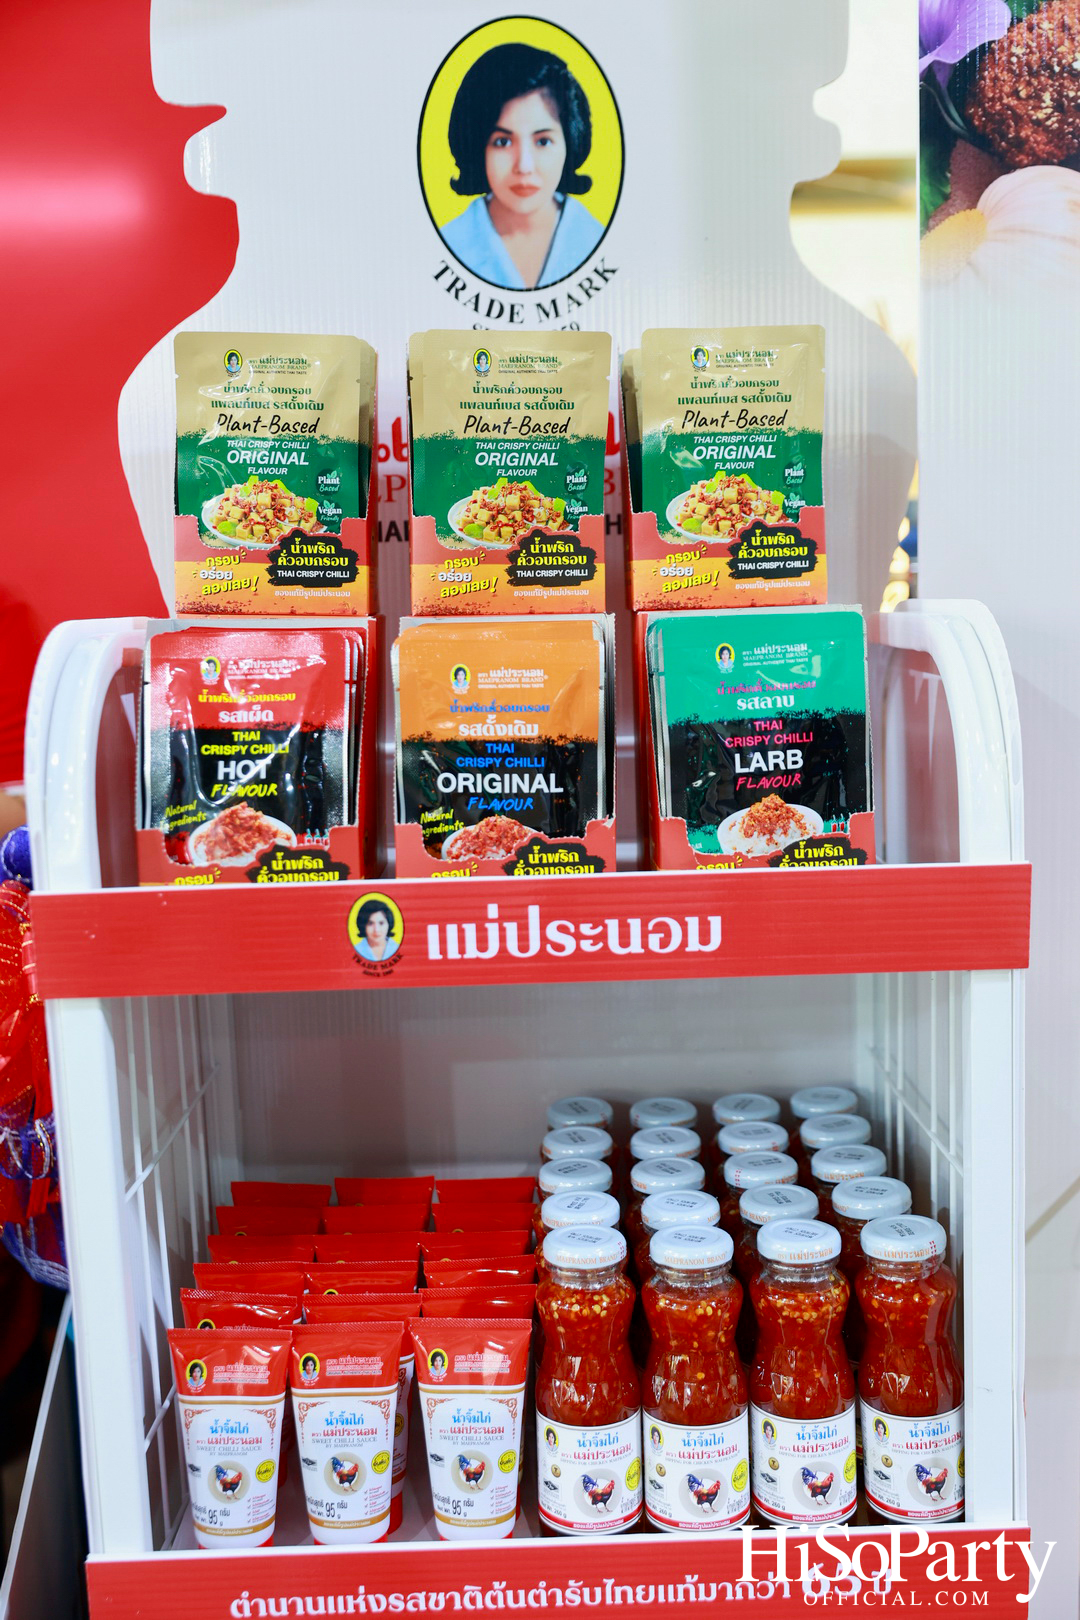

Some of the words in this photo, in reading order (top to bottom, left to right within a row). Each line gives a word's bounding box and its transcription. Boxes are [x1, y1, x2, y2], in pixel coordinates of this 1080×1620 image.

[433, 260, 524, 324] TRADE
[535, 257, 620, 324] MARK
[472, 381, 563, 395] น้ำพริกคั่วอบกรอบ
[211, 398, 270, 410] แพลนท์เบส
[273, 396, 325, 411] รสดั้งเดิม
[460, 398, 521, 410] แพลนท์เบส
[524, 396, 575, 411] รสดั้งเดิม
[677, 393, 738, 405] แพลนท์เบส
[741, 389, 792, 404] รสดั้งเดิม
[217, 413, 321, 434] Plant-Based
[463, 414, 571, 436] Plant-Based
[682, 408, 788, 429] Plant-Based
[227, 440, 247, 448] THAI
[248, 440, 281, 449] CRISPY
[282, 441, 310, 449] CHILLI
[475, 441, 495, 450] THAI
[496, 441, 531, 451] CRISPY
[532, 441, 560, 450] CHILLI
[693, 436, 714, 444] THAI
[715, 435, 748, 444] CRISPY
[749, 434, 777, 442] CHILLI
[227, 450, 310, 466] ORIGINAL
[475, 451, 559, 466] ORIGINAL
[693, 444, 776, 460] ORIGINAL
[247, 466, 288, 475] FLAVOUR
[496, 468, 538, 477] FLAVOUR
[714, 462, 755, 470] FLAVOUR
[784, 468, 804, 477] Plant
[318, 475, 340, 485] Plant
[566, 474, 587, 484] Plant
[786, 476, 804, 485] Based
[319, 484, 340, 492] Based
[567, 482, 586, 492] Based
[565, 504, 588, 515] Vegan
[784, 498, 806, 508] Vegan
[318, 506, 343, 516] Vegan
[751, 529, 795, 545] น้ำพริก
[290, 538, 336, 555] น้ำพริก
[530, 537, 574, 554] น้ำพริก
[738, 542, 808, 559] คั่วอบกรอบ
[205, 555, 240, 568] กรอบ
[277, 549, 349, 566] คั่วอบกรอบ
[444, 556, 479, 570] กรอบ
[517, 549, 587, 566] คั่วอบกรอบ
[666, 550, 700, 565] กรอบ
[660, 564, 694, 577] อร่อย
[738, 563, 756, 571] THAI
[757, 562, 784, 570] CRISPY
[785, 560, 809, 569] CHILLI
[199, 567, 233, 581] อร่อย
[277, 570, 295, 578] THAI
[296, 570, 324, 578] CRISPY
[325, 570, 350, 578] CHILLI
[438, 569, 472, 582] อร่อย
[516, 570, 535, 578] THAI
[536, 569, 563, 578] CRISPY
[564, 569, 588, 578] CHILLI
[737, 695, 794, 711] รสลาบ
[218, 704, 274, 723] รสเผ็ด
[459, 714, 538, 736] รสดั้งเดิม
[754, 720, 782, 732] THAI
[232, 731, 261, 742] THAI
[725, 734, 771, 748] CRISPY
[774, 732, 814, 744] CHILLI
[200, 745, 248, 756] CRISPY
[250, 744, 290, 754] CHILLI
[485, 743, 515, 754] THAI
[456, 757, 502, 768] CRISPY
[504, 757, 545, 768] CHILLI
[734, 749, 804, 774] LARB
[217, 759, 272, 781] HOT
[436, 772, 564, 794] ORIGINAL
[736, 773, 802, 791] FLAVOUR
[467, 797, 534, 812] FLAVOUR
[420, 809, 454, 824] Natural
[421, 821, 464, 837] ngredients
[528, 846, 579, 864] น้ำพริก
[794, 841, 844, 859] น้ำพริก
[271, 852, 324, 871] น้ำพริก
[426, 903, 723, 960] แม่ประนอม
[556, 1255, 597, 1265] MAEPRANOM
[664, 1255, 705, 1265] MAEPRANOM
[789, 1247, 833, 1260] แม่ประนอม
[883, 1247, 930, 1259] แม่ประนอม
[325, 1411, 364, 1427] น้ำจิ้มไก่
[452, 1408, 491, 1424] น้ำจิ้มไก่
[210, 1420, 249, 1434] น้ำจิ้มไก่
[323, 1426, 378, 1437] แม่ประนอม
[450, 1423, 505, 1434] แม่ประนอม
[796, 1425, 838, 1440] น้ำจิ้มไก่
[909, 1421, 950, 1438] น้ำจิ้มไก่
[207, 1434, 263, 1445] แม่ประนอม
[577, 1432, 619, 1448] น้ำจิ้มไก่
[682, 1432, 724, 1447] น้ำจิ้มไก่
[792, 1437, 849, 1453] แม่ประนอม
[906, 1432, 961, 1450] แม่ประนอม
[573, 1443, 632, 1460] แม่ประนอม
[678, 1443, 738, 1460] แม่ประนอม
[325, 1502, 336, 1518] 95
[452, 1500, 462, 1515] 95
[208, 1509, 218, 1525] 95
